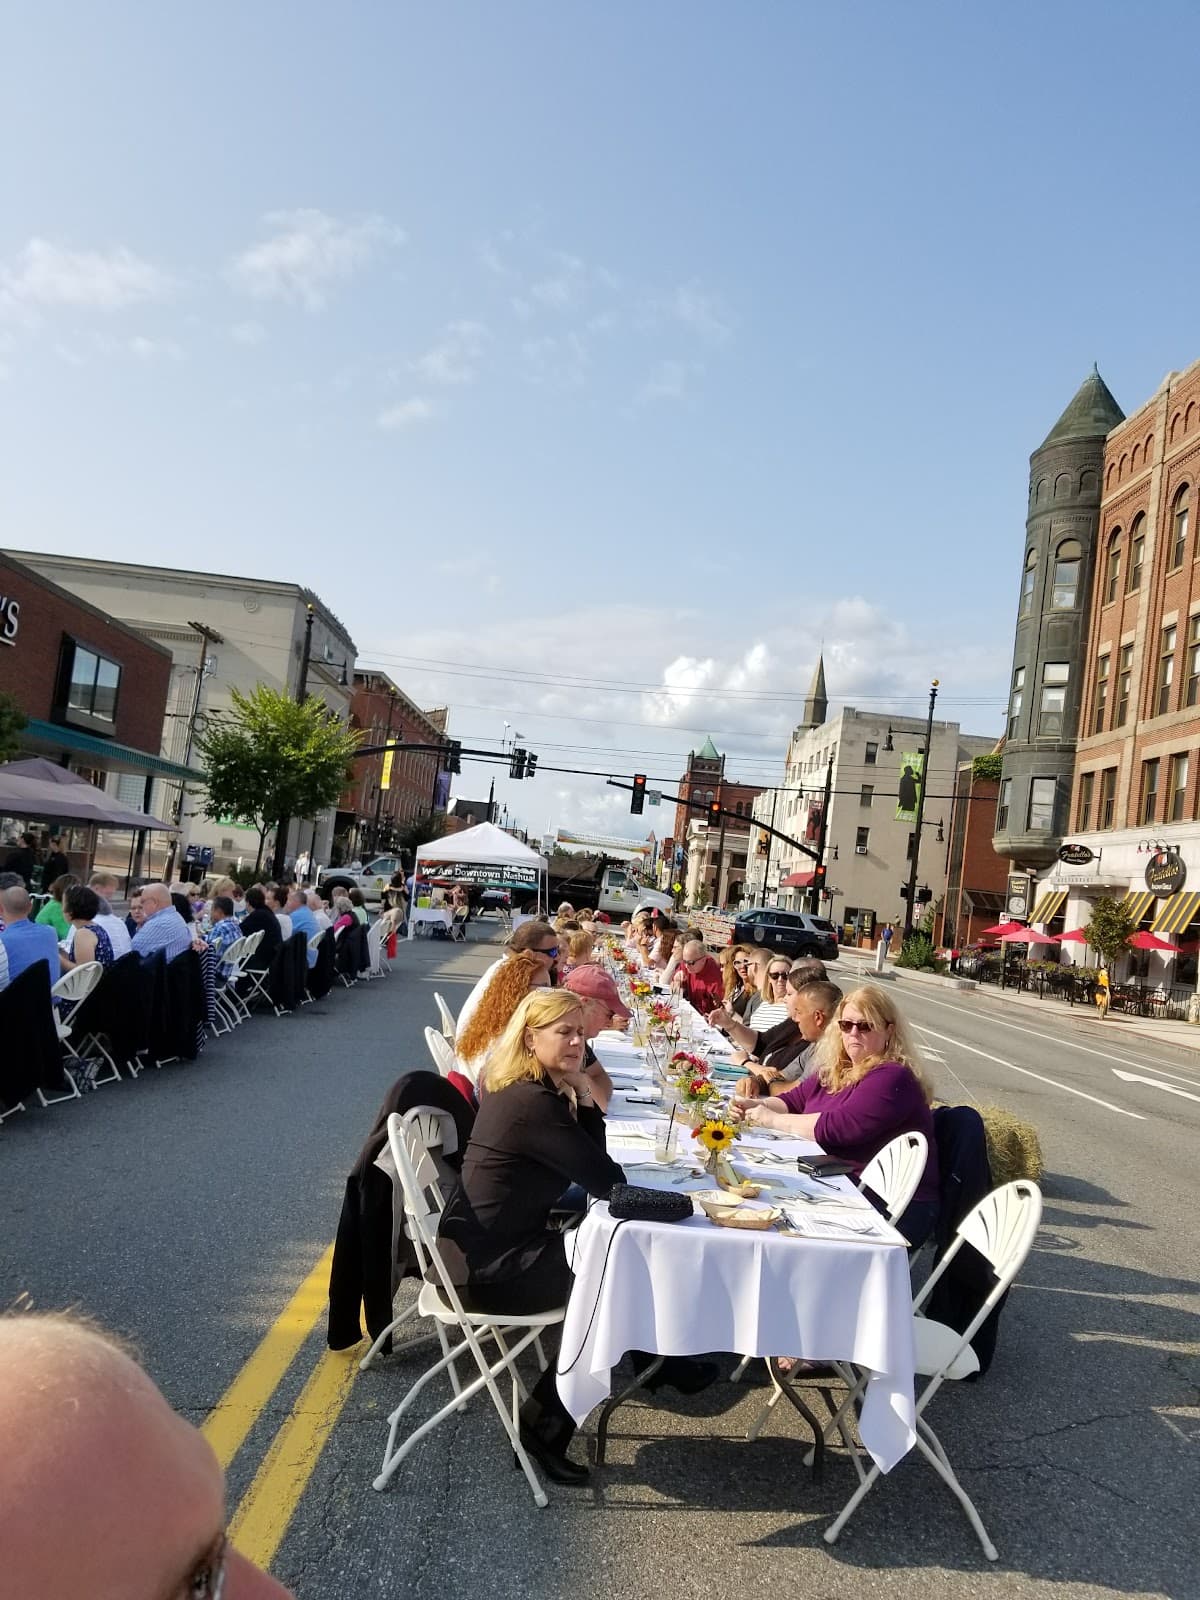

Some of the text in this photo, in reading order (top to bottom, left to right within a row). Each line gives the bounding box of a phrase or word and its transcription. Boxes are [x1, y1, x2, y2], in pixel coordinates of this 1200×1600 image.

[421, 867, 436, 875] We
[438, 867, 453, 876] Are
[454, 867, 501, 879] Downtown
